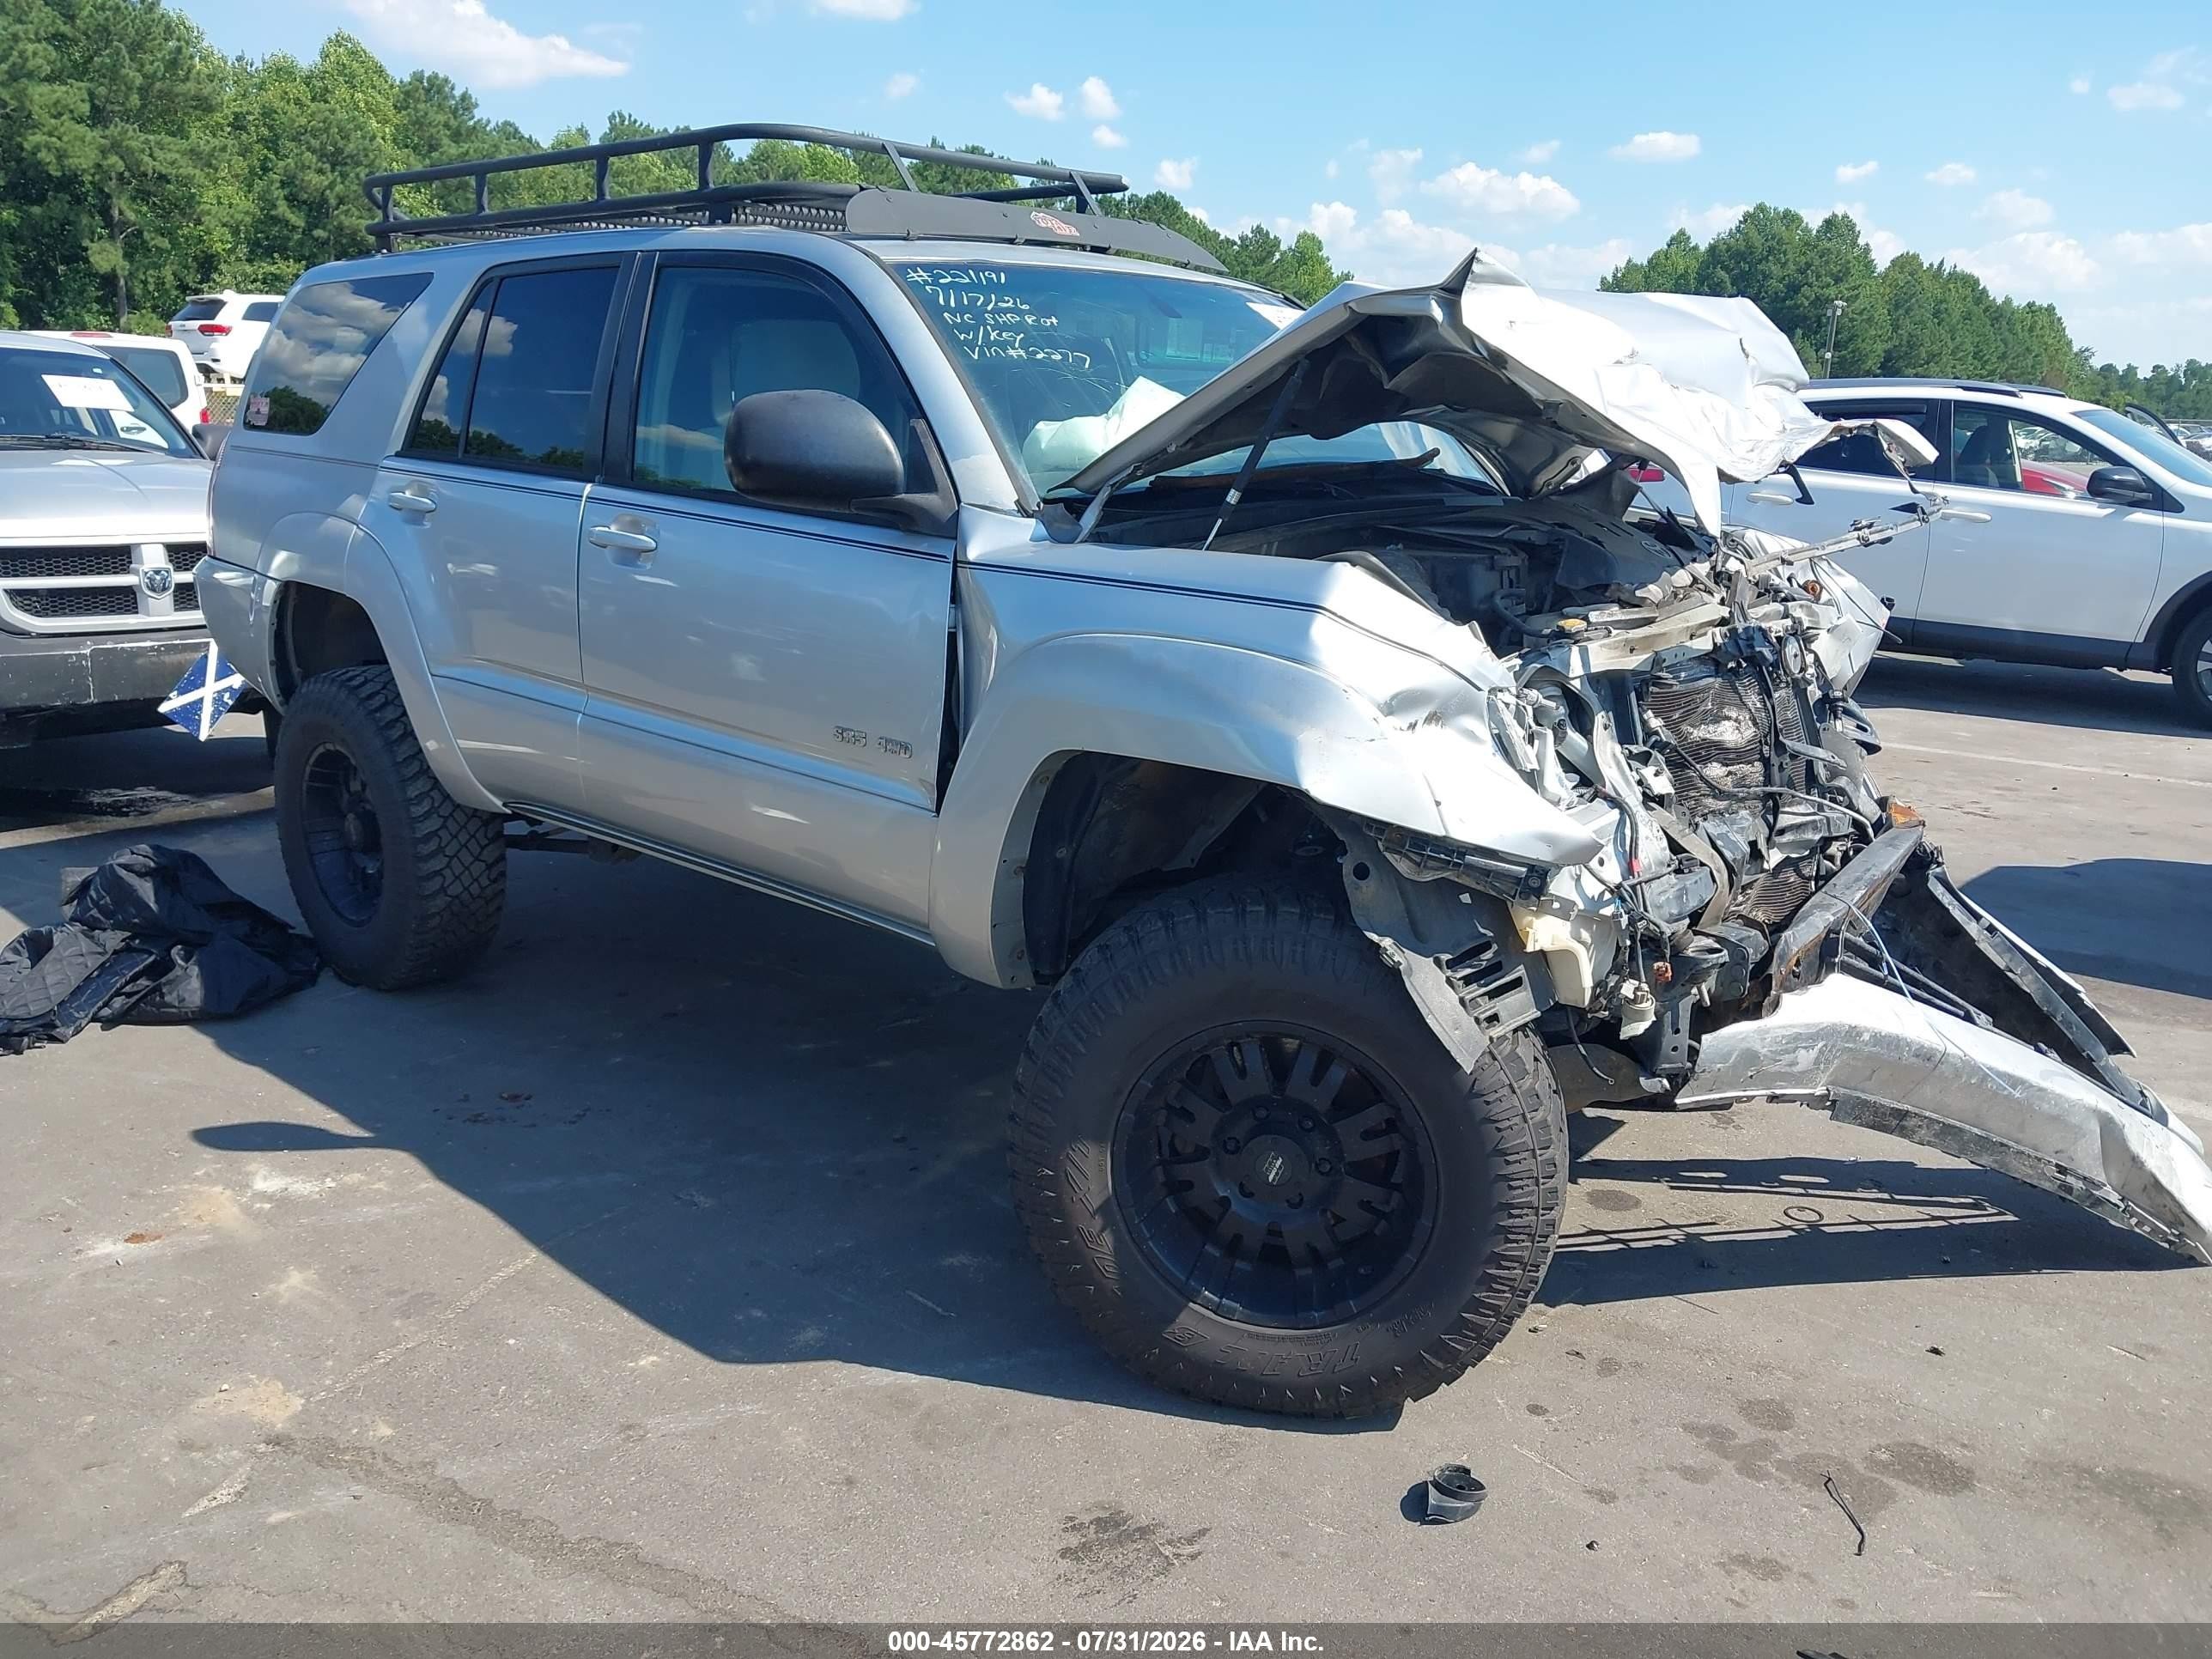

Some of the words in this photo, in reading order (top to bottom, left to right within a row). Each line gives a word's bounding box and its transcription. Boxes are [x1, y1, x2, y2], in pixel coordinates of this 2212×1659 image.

[925, 284, 1030, 312] 7/17/26
[943, 311, 976, 325] NC
[832, 726, 867, 748] SR5
